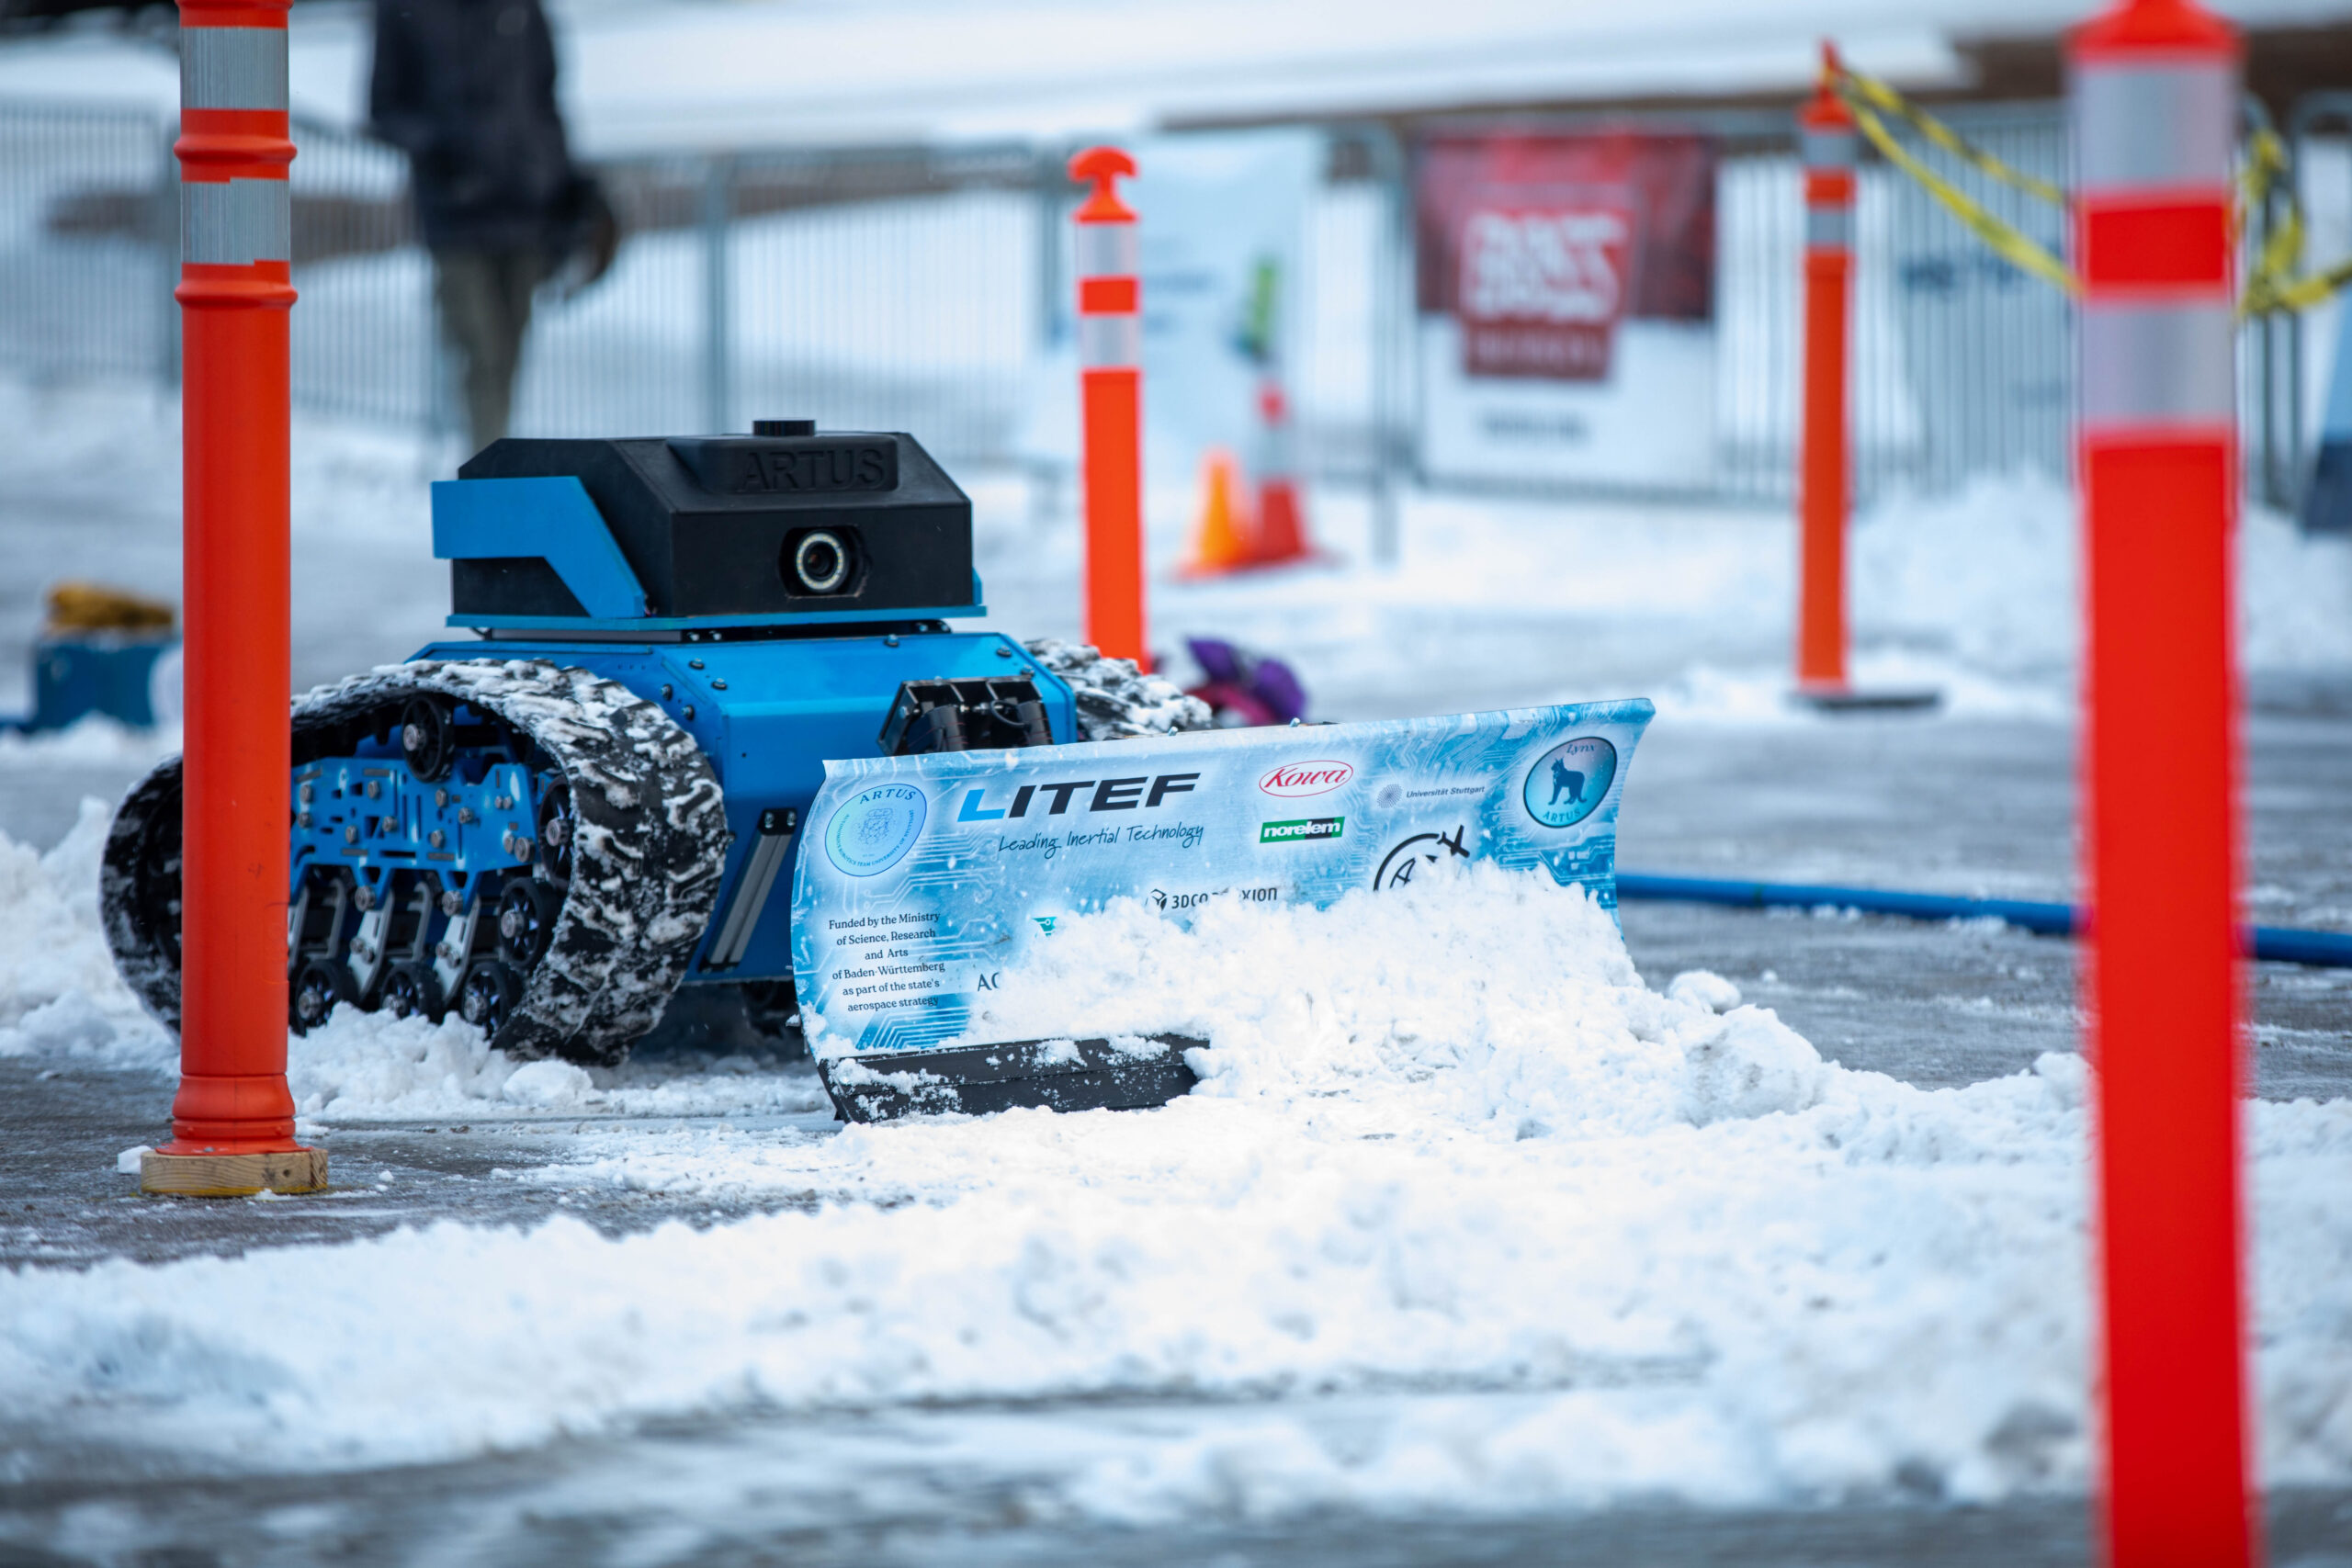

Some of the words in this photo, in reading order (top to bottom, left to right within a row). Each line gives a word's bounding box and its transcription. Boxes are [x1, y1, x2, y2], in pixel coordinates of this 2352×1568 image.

[736, 448, 886, 492] ARTUS
[1566, 744, 1595, 756] Lynx
[1264, 766, 1349, 788] Kowa
[859, 788, 917, 805] ARTUS
[957, 773, 1201, 823] LITEF
[1407, 788, 1449, 798] Universität
[1450, 786, 1486, 795] Stuttgart
[1543, 808, 1581, 823] ARTUS
[1263, 820, 1341, 838] norelem
[998, 832, 1062, 860] Leading
[1067, 826, 1120, 847] Inertial
[1126, 821, 1204, 849] Technology
[829, 916, 865, 930] Funded
[867, 917, 879, 928] by
[880, 915, 898, 925] the
[899, 912, 941, 923] Ministry
[836, 936, 847, 946] of
[848, 934, 889, 945] Science,
[890, 928, 936, 942] Research
[865, 949, 884, 961] and
[887, 948, 909, 958] Arts
[832, 969, 842, 980] of
[842, 987, 854, 996] as
[855, 985, 877, 997] part
[878, 982, 888, 992] of
[889, 981, 907, 992] the
[908, 978, 940, 989] state's
[847, 1000, 898, 1012] aerospace
[899, 996, 940, 1008] strategy
